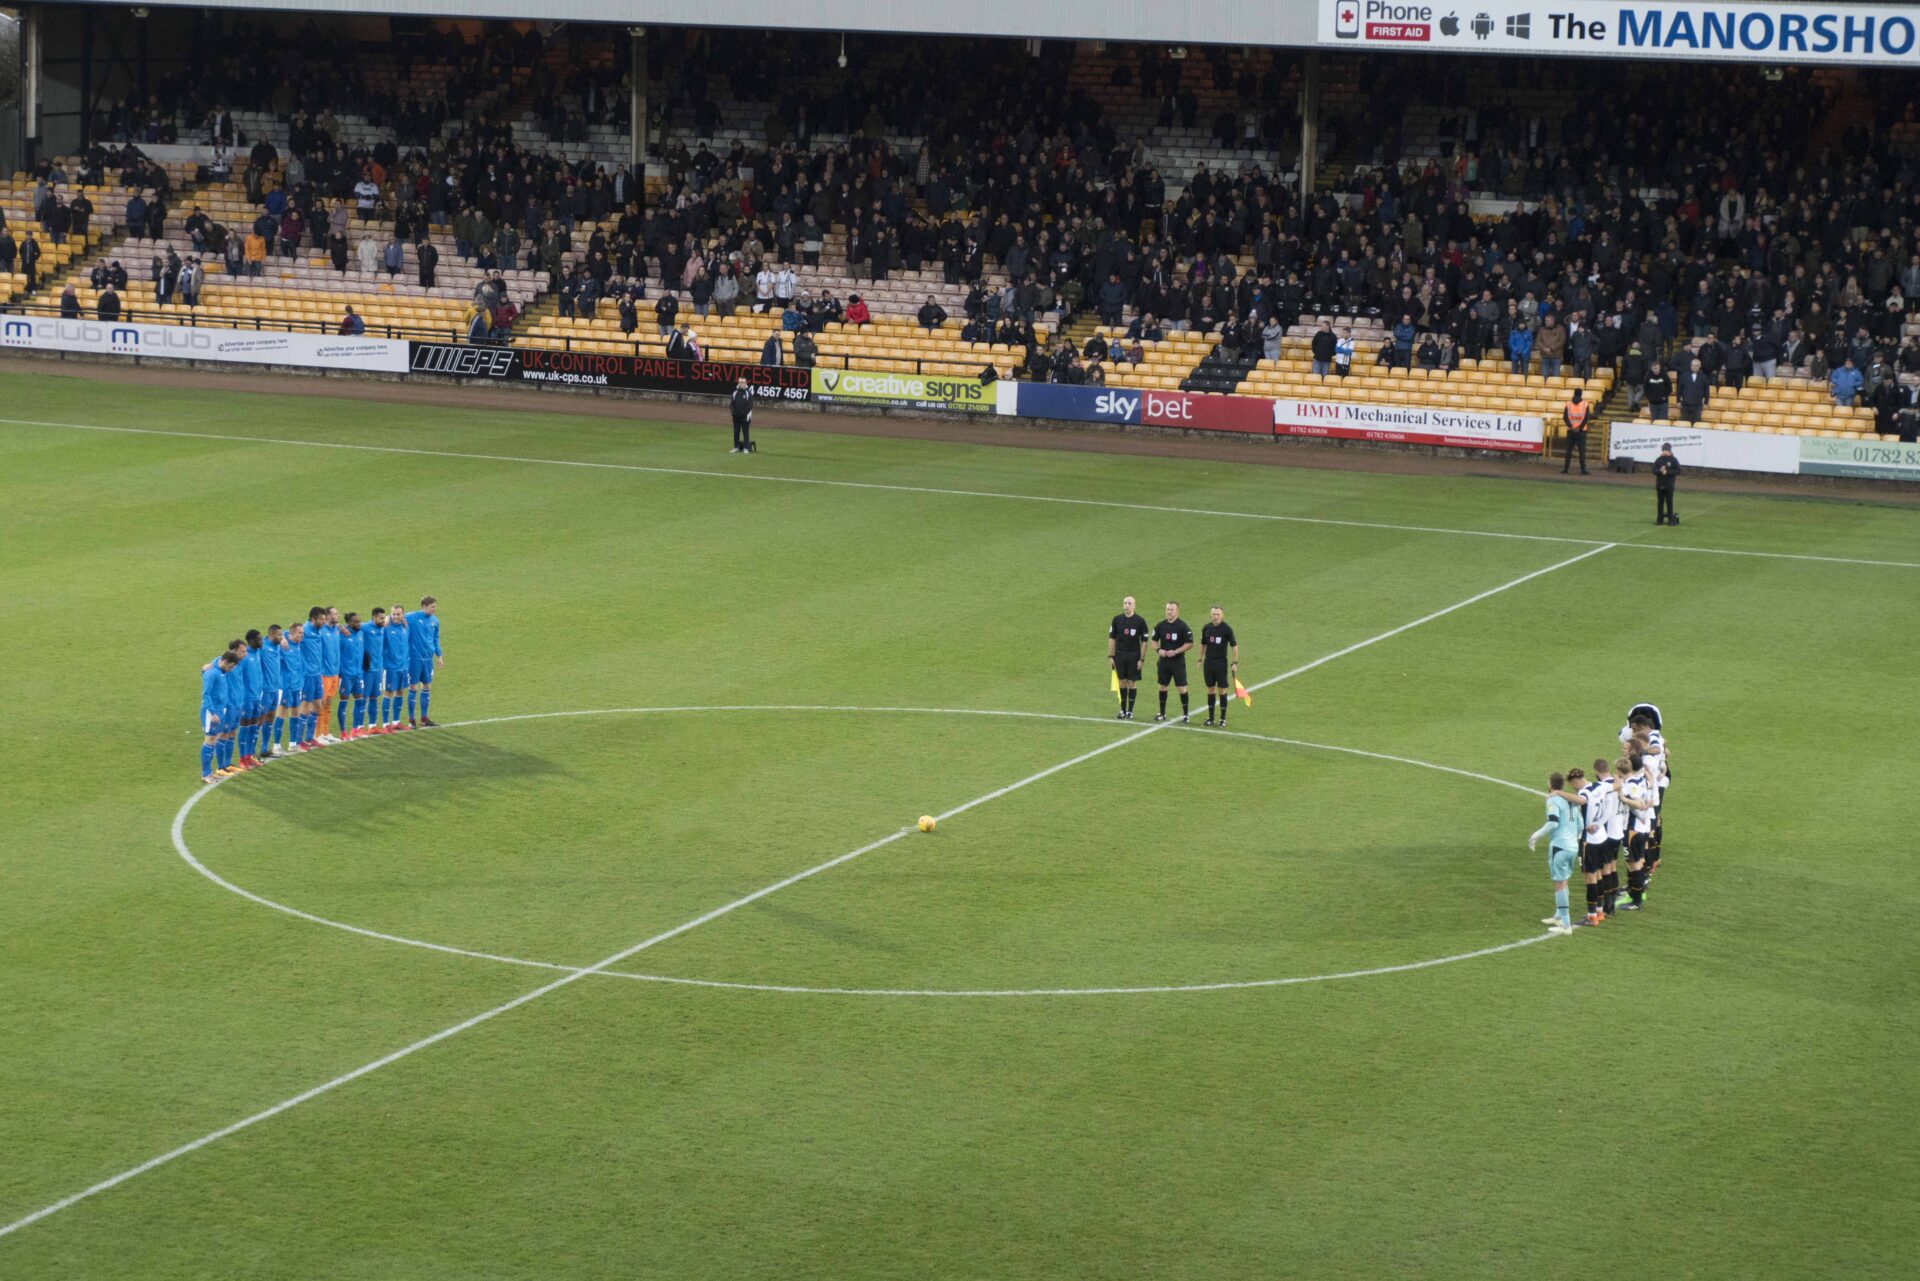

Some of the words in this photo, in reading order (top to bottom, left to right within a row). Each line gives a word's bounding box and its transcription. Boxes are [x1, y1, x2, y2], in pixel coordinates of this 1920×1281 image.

[1366, 0, 1432, 20] Phone
[1372, 27, 1402, 36] FIRST
[1405, 28, 1423, 37] AID
[1548, 13, 1606, 40] The
[522, 351, 544, 369] UK
[550, 352, 627, 375] CONTROL
[634, 358, 684, 379] PANEL
[691, 362, 772, 385] SERVICES
[779, 368, 809, 387] LTD
[523, 370, 608, 385] www.uk-cps.co.uk
[757, 386, 781, 397] 4567
[784, 388, 808, 399] 4567
[842, 375, 924, 396] creative
[926, 381, 982, 402] signs
[1095, 388, 1139, 420] sky
[1147, 393, 1192, 419] bet
[1297, 404, 1339, 418] HMM
[1345, 407, 1427, 425] Mechanical
[1432, 412, 1491, 430] Services
[1496, 417, 1521, 432] Ltd
[1853, 446, 1902, 464] 01782
